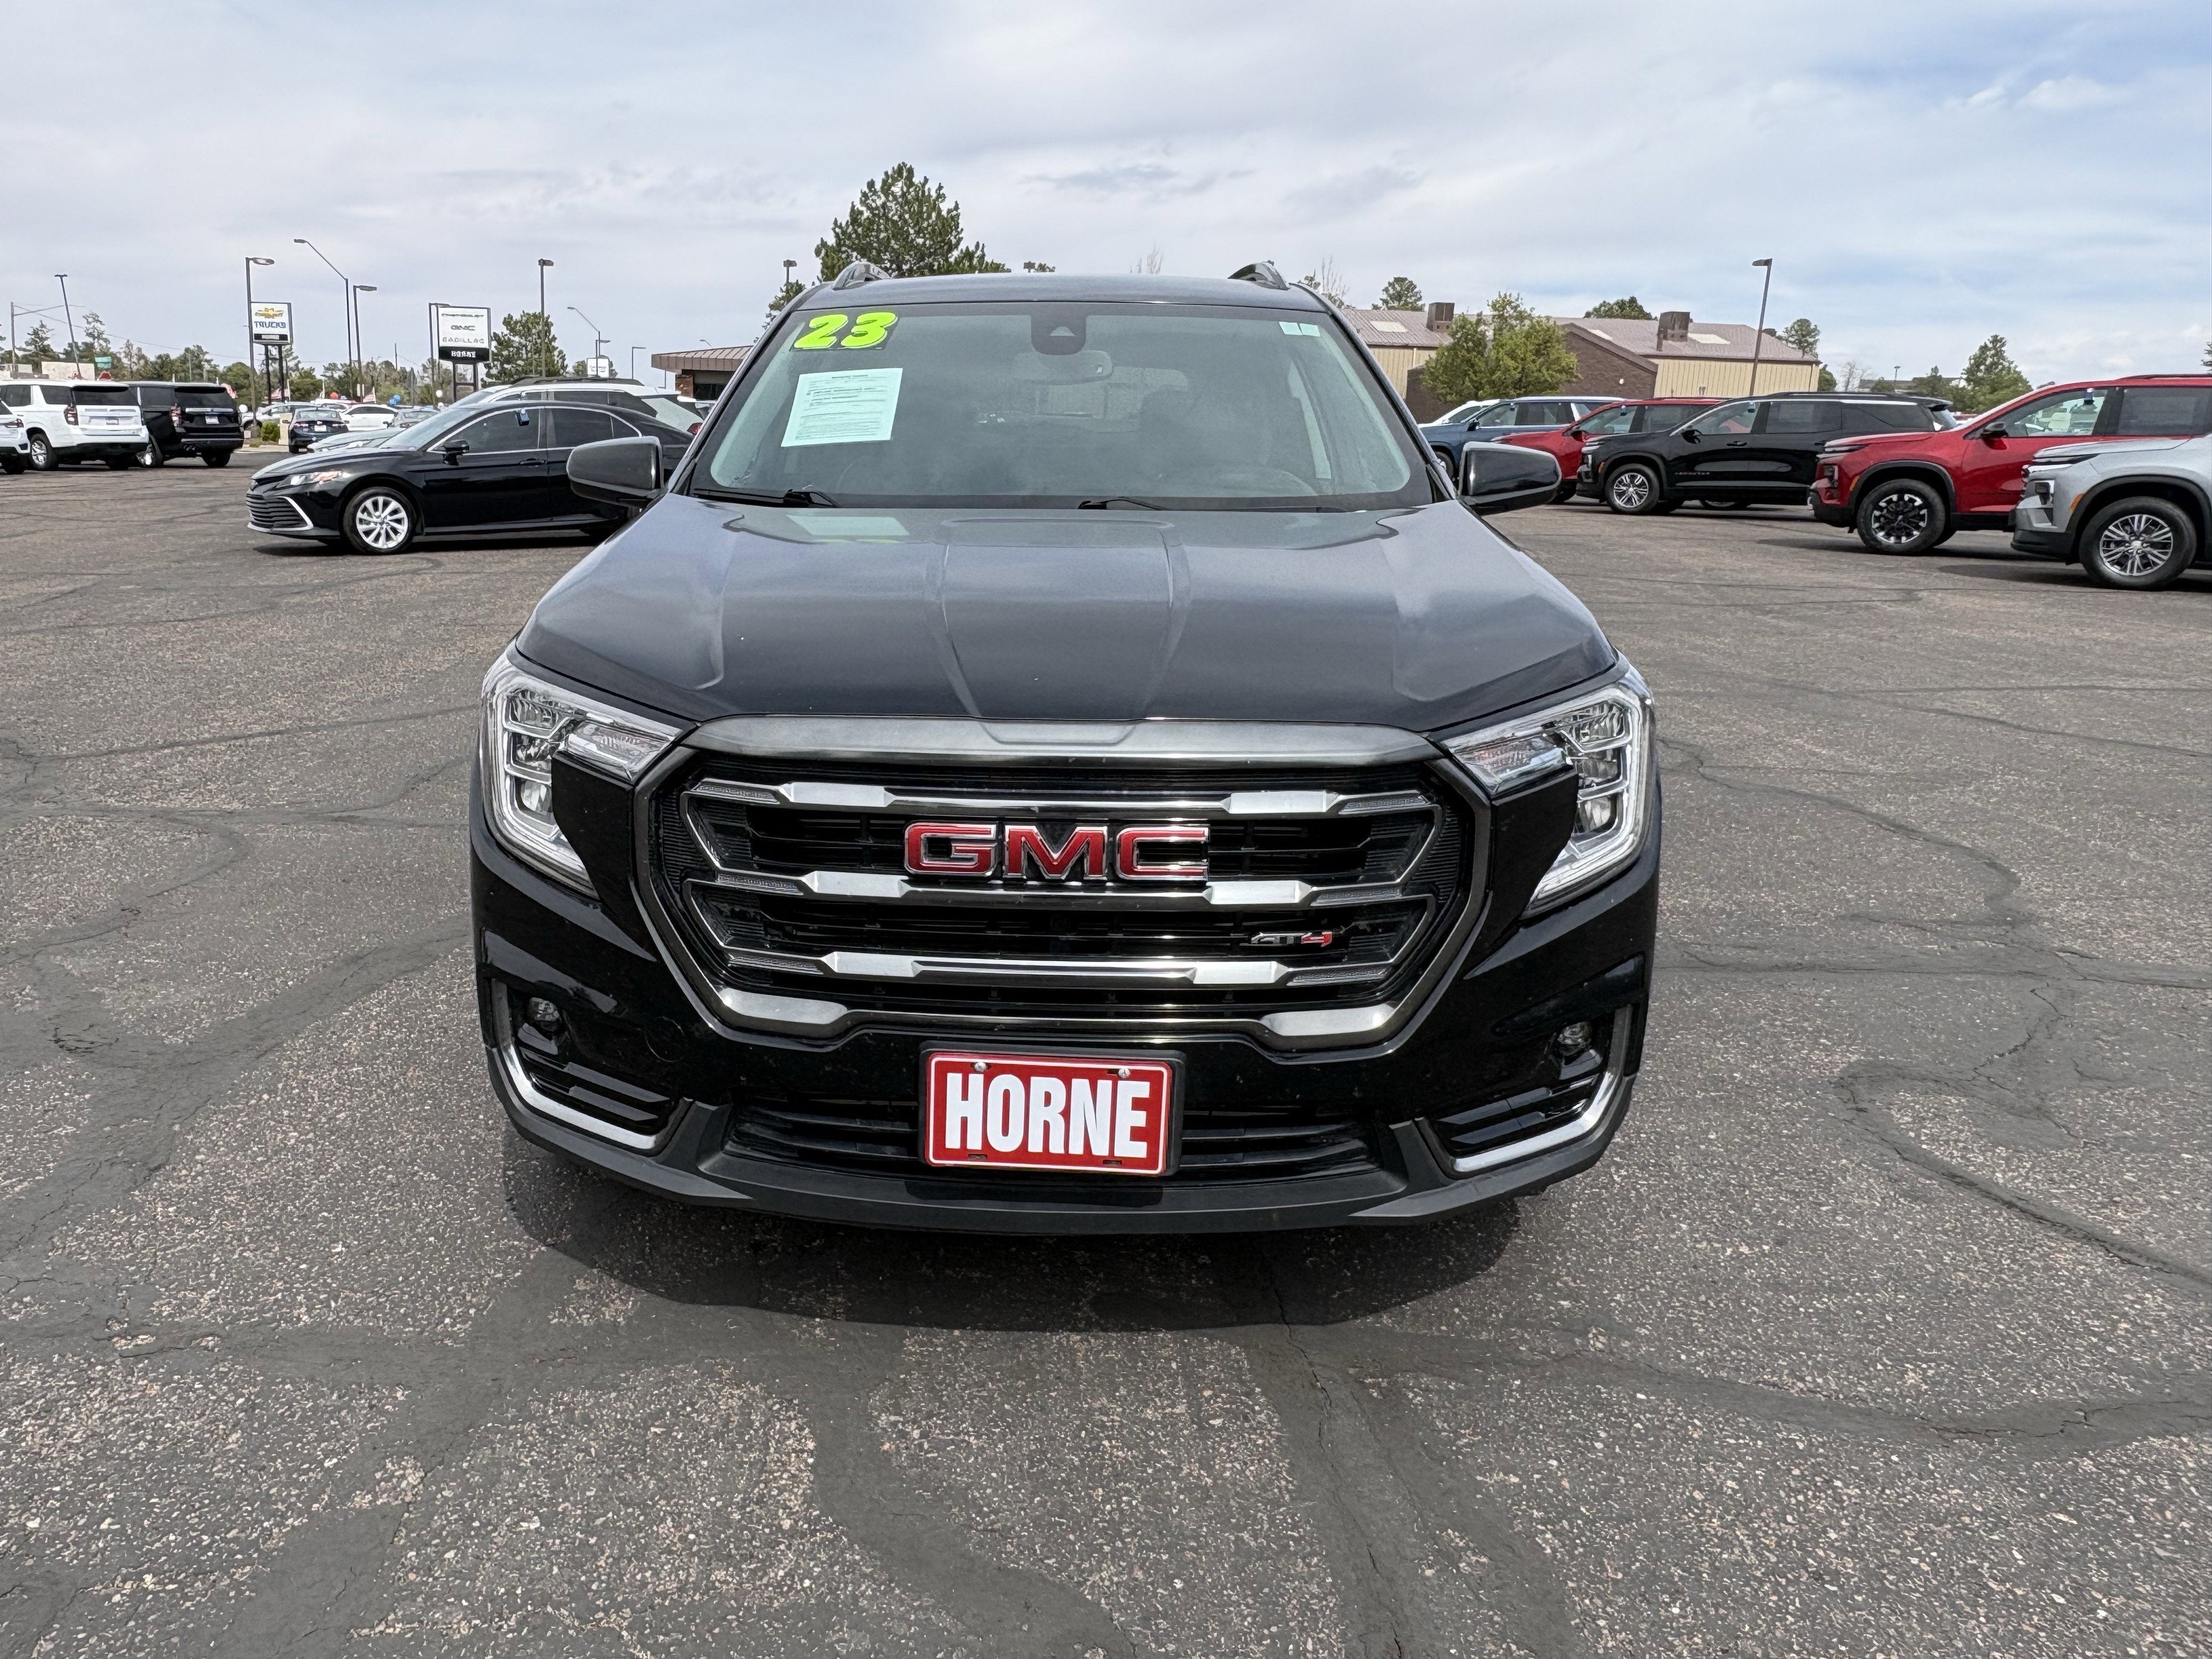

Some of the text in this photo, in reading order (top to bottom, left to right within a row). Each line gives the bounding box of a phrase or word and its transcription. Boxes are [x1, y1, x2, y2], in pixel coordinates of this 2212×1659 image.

[794, 312, 898, 348] 23
[904, 823, 1208, 880] GMC
[945, 1073, 1150, 1158] HORNE
